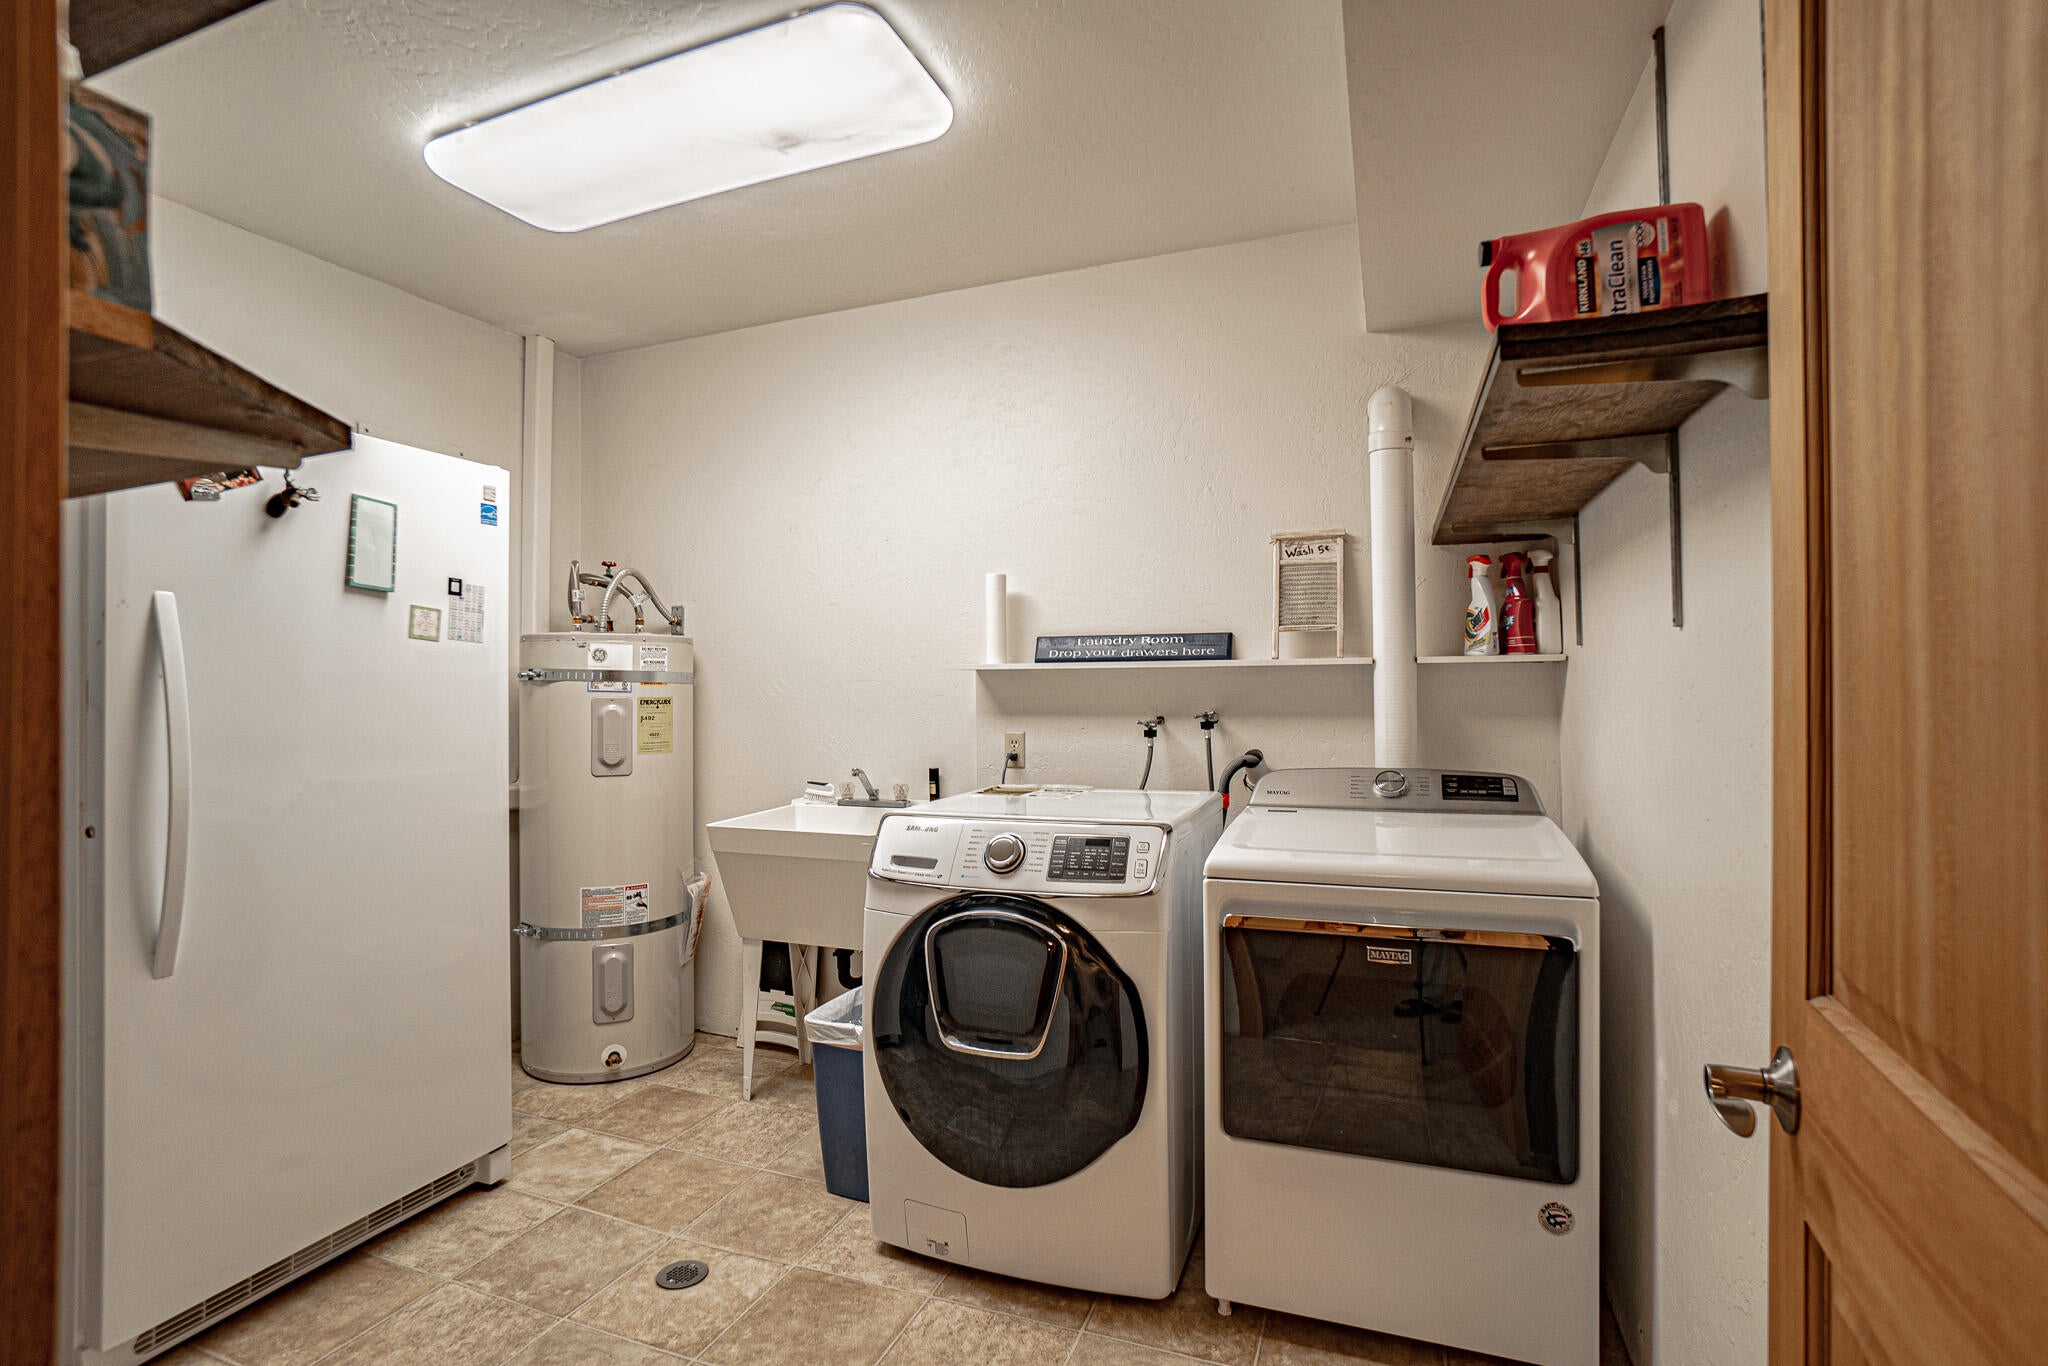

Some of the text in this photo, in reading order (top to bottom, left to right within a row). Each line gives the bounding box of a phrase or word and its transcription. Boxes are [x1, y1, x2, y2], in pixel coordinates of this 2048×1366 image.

[1576, 259, 1590, 312] KIRKLAND
[1285, 545, 1314, 558] Wash
[1077, 635, 1184, 647] Laundry Room
[1049, 647, 1215, 658] Drop your drawers here
[1370, 950, 1409, 961] MAYTAG
